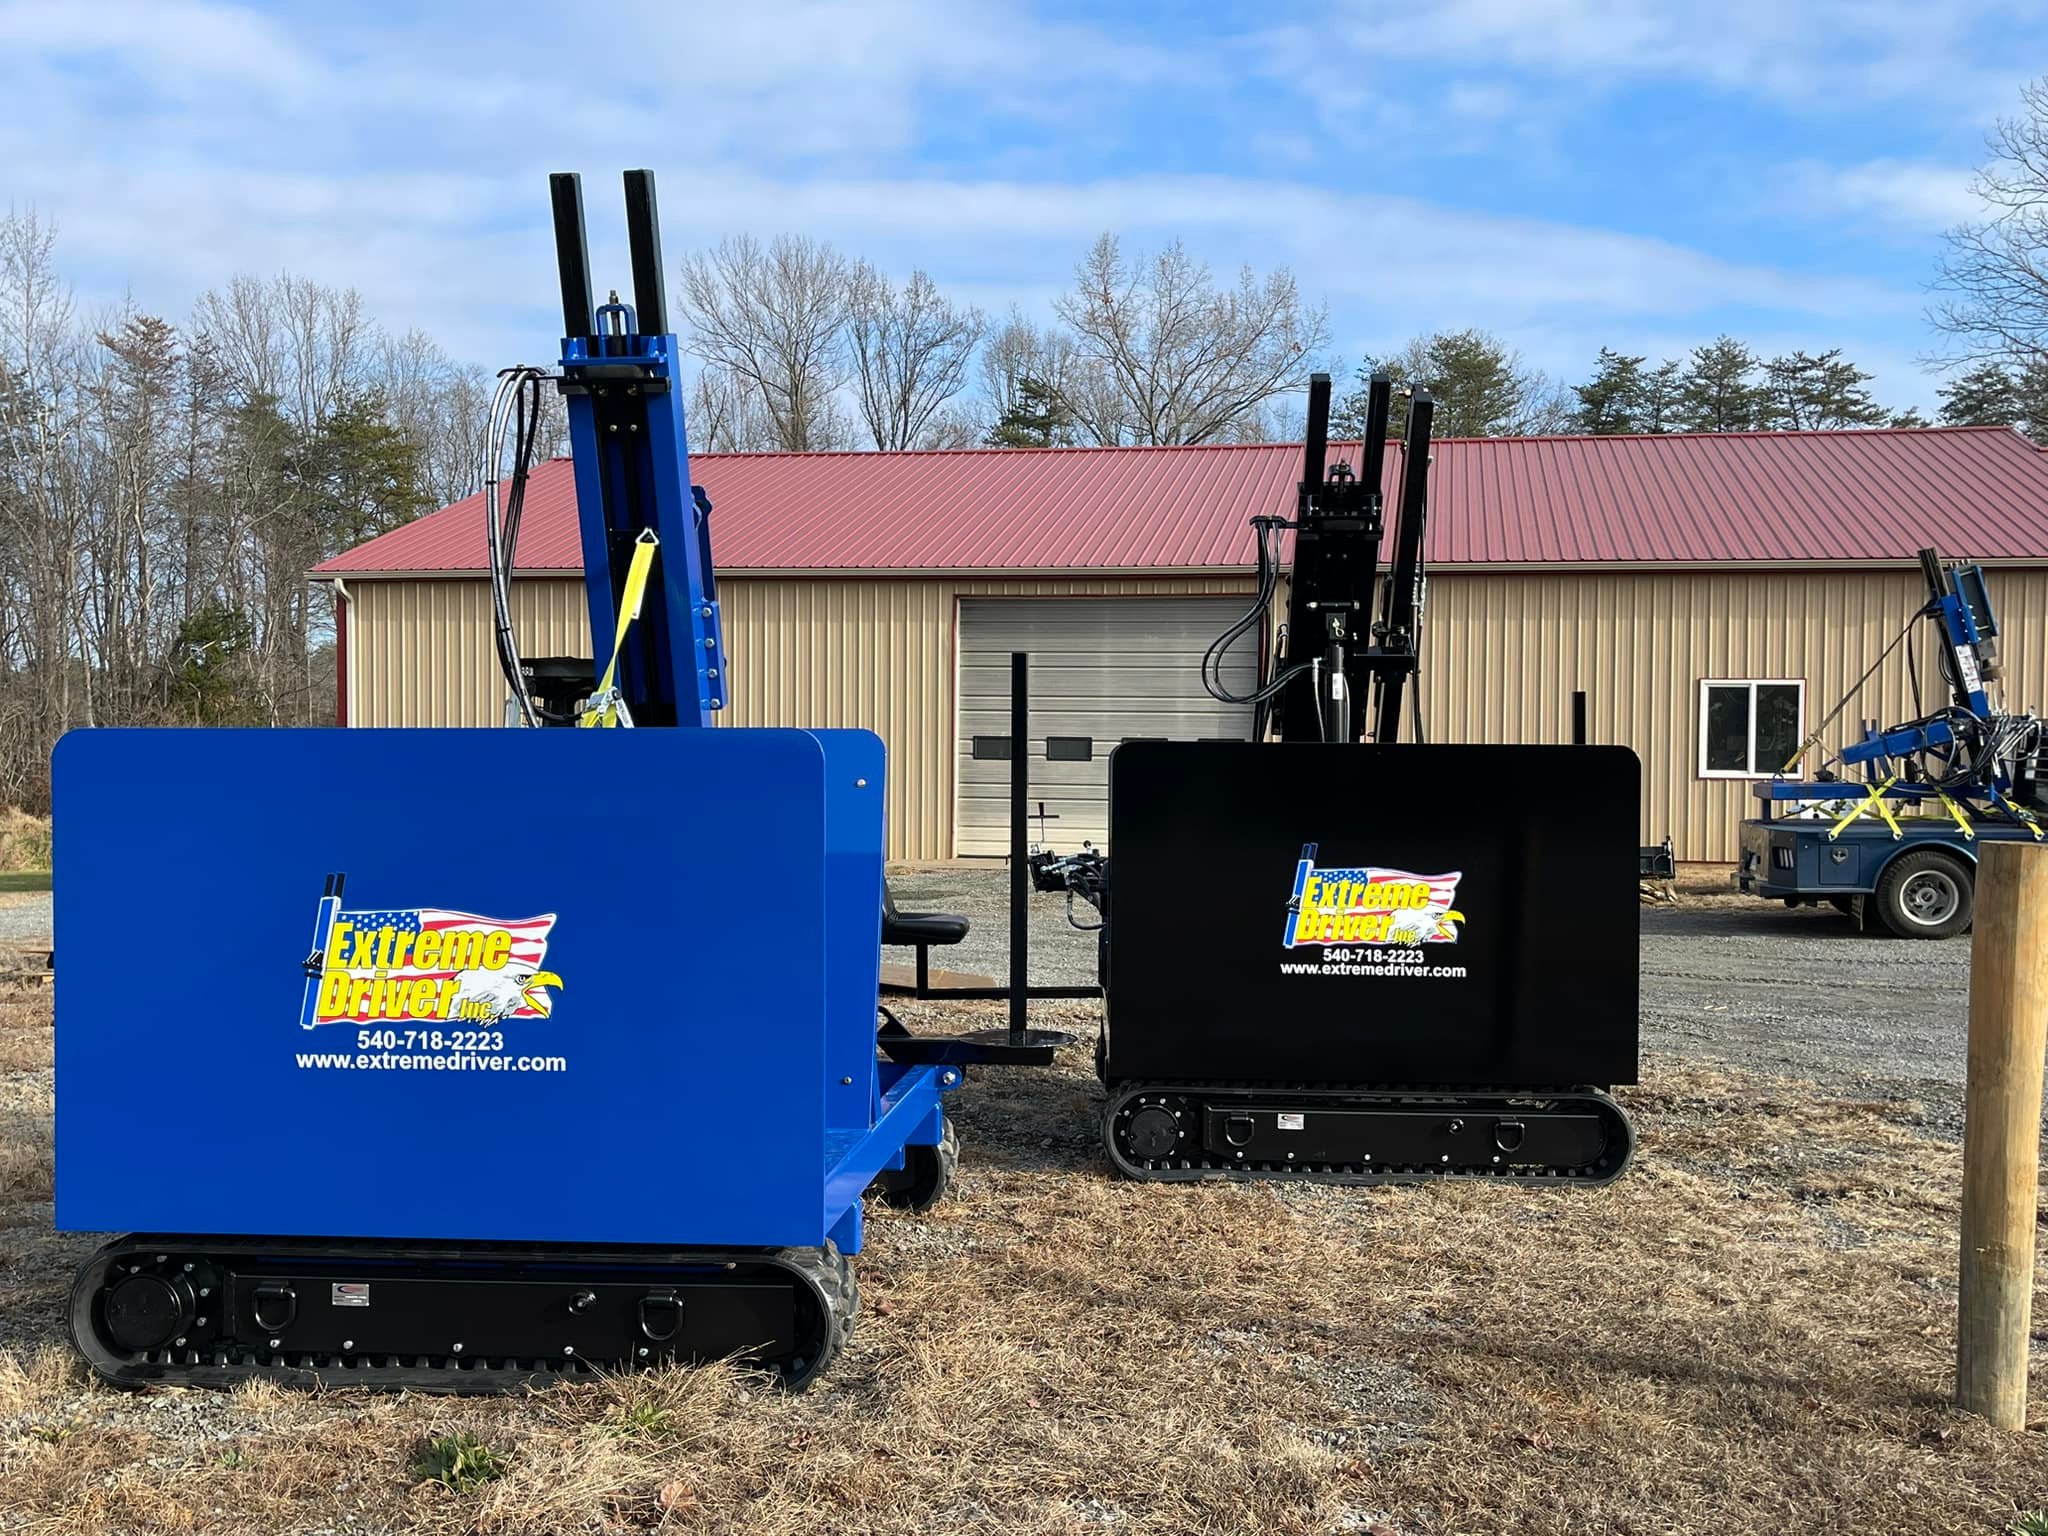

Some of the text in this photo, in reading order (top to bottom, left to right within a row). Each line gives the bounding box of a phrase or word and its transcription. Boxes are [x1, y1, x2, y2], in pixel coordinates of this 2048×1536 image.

[1303, 876, 1431, 909] Extreme
[1297, 908, 1396, 941] Driver
[326, 921, 512, 970] Extreme
[1323, 948, 1425, 963] 540-718-2223
[1280, 963, 1467, 978] www.extremedriver.com
[318, 970, 462, 1018] Driver
[357, 1031, 504, 1050] 540-718-2223
[296, 1051, 567, 1072] www.extremedriver.com
